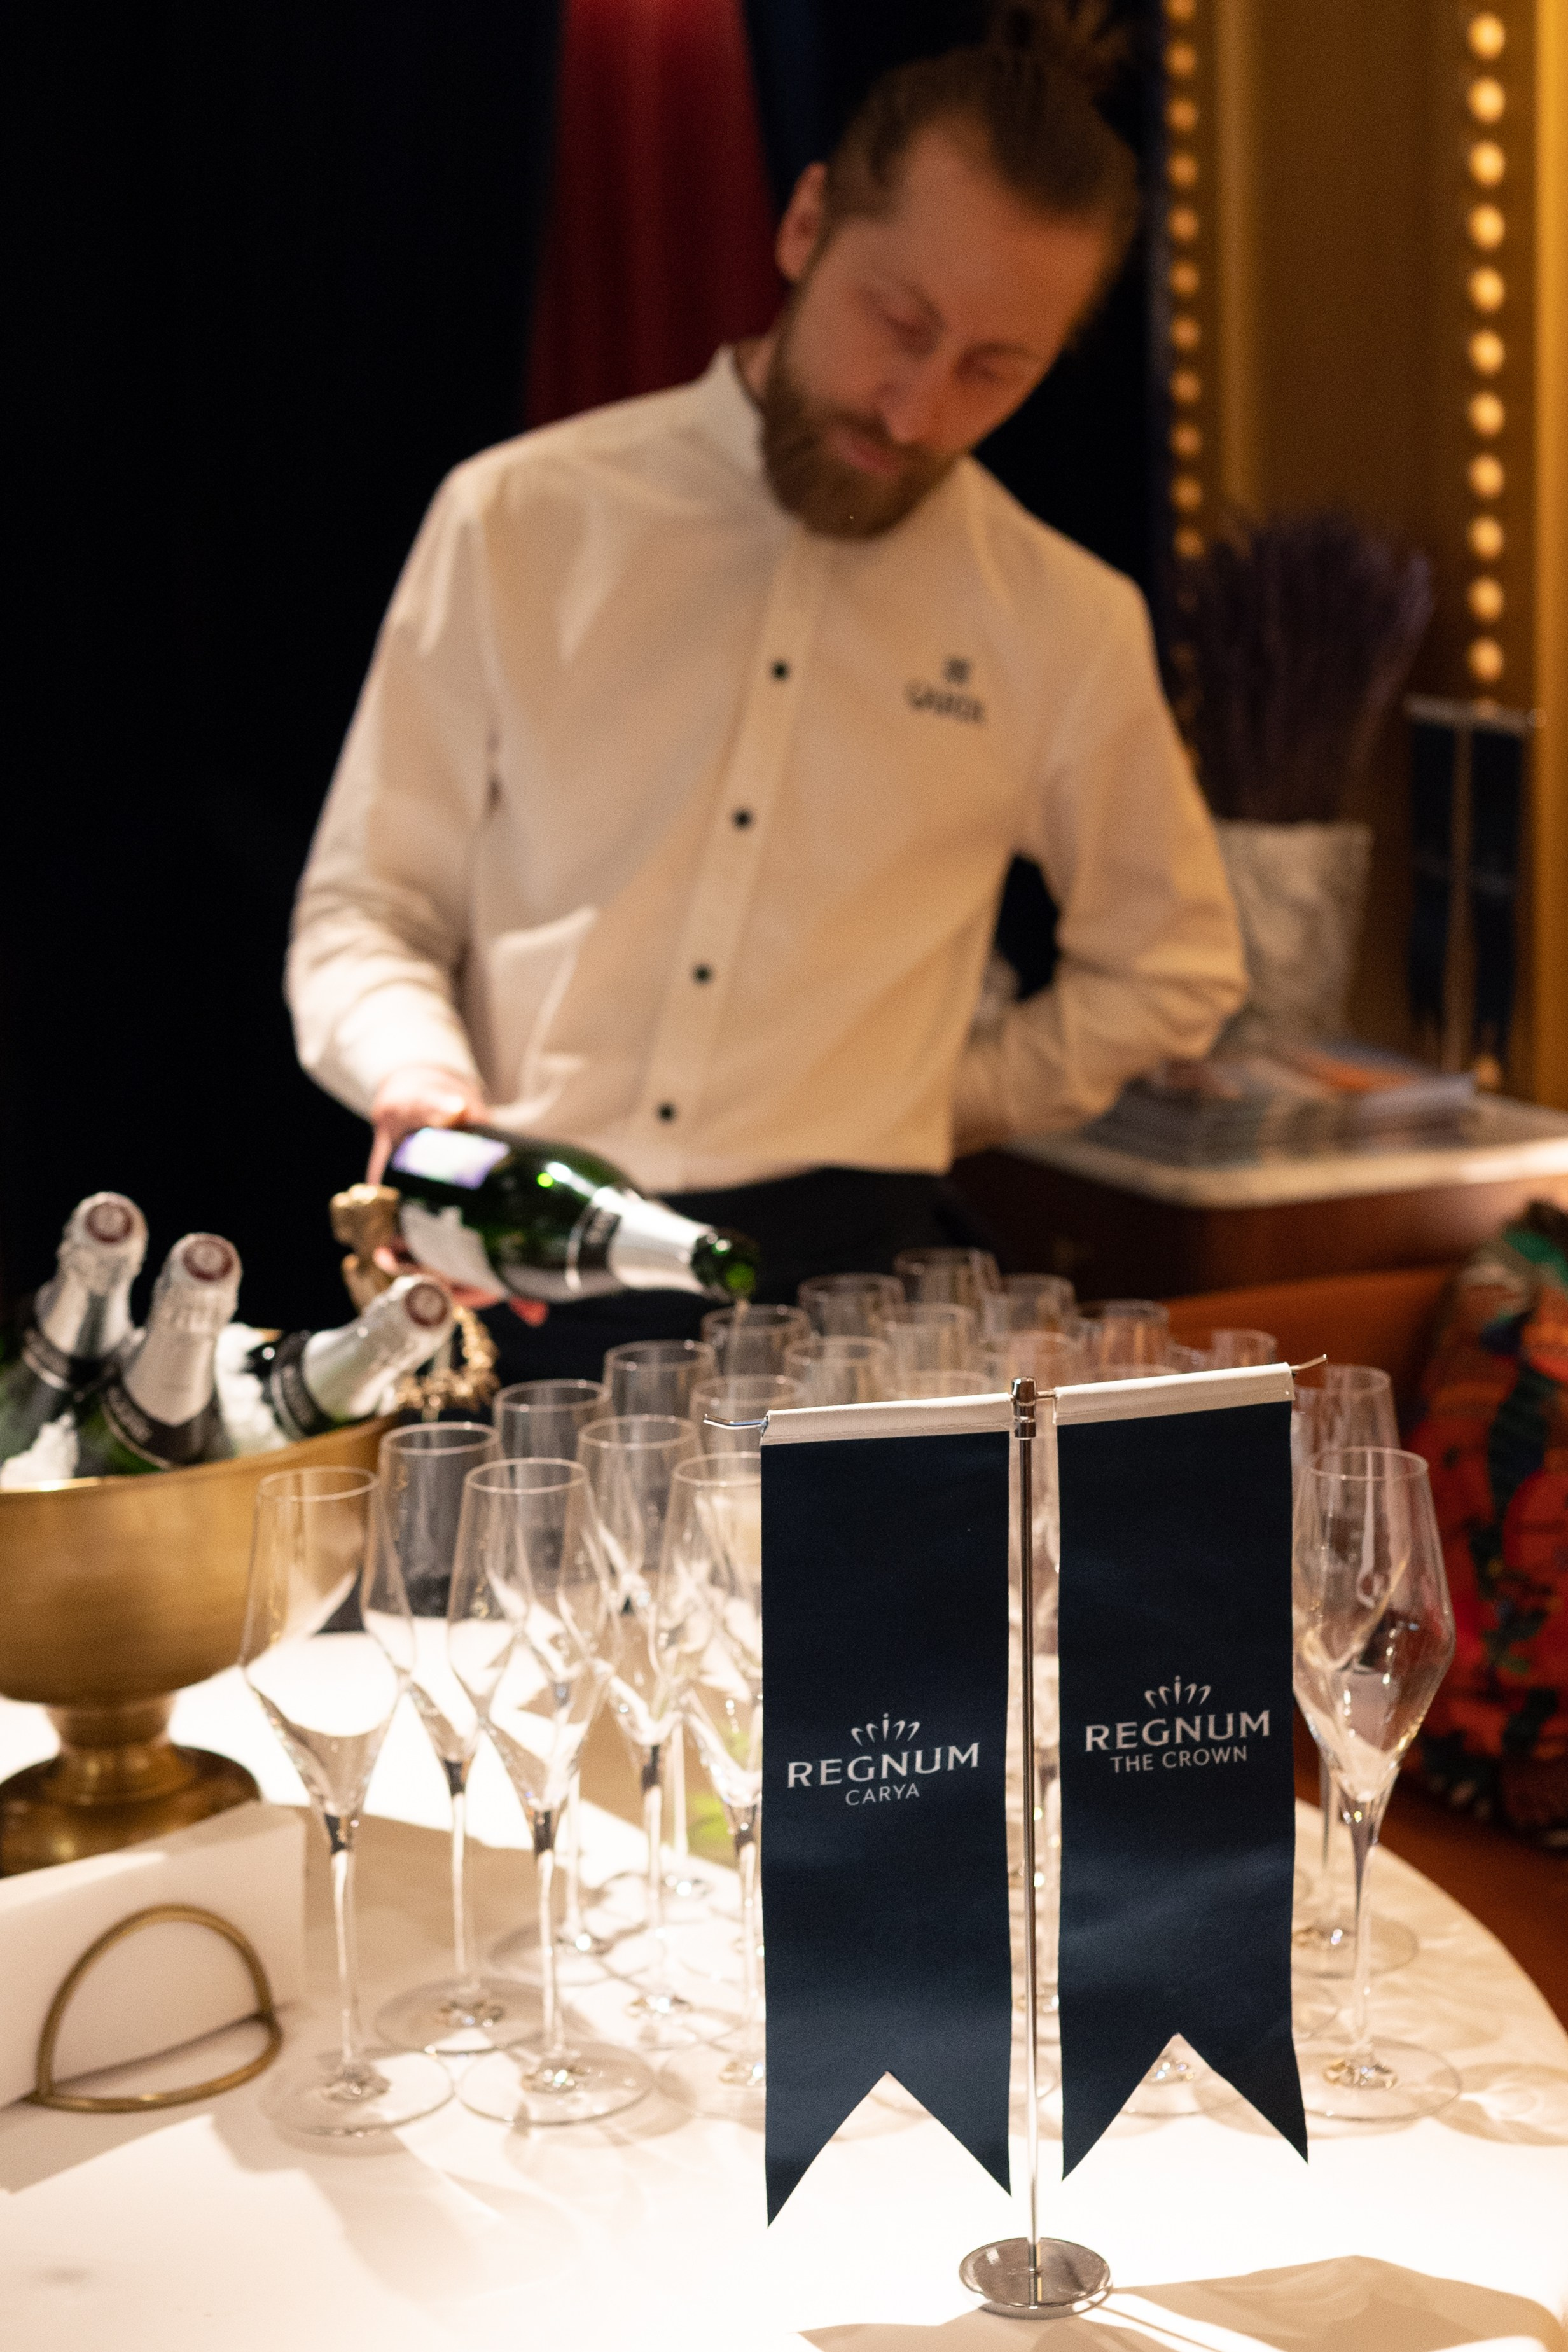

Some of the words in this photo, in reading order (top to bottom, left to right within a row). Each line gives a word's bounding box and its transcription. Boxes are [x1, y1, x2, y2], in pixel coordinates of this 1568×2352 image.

[1085, 1709, 1270, 1752] REGNUM
[787, 1741, 980, 1789] REGNUM
[1110, 1754, 1153, 1774] THE
[1162, 1745, 1247, 1771] CROWN
[845, 1783, 920, 1806] CARYA
